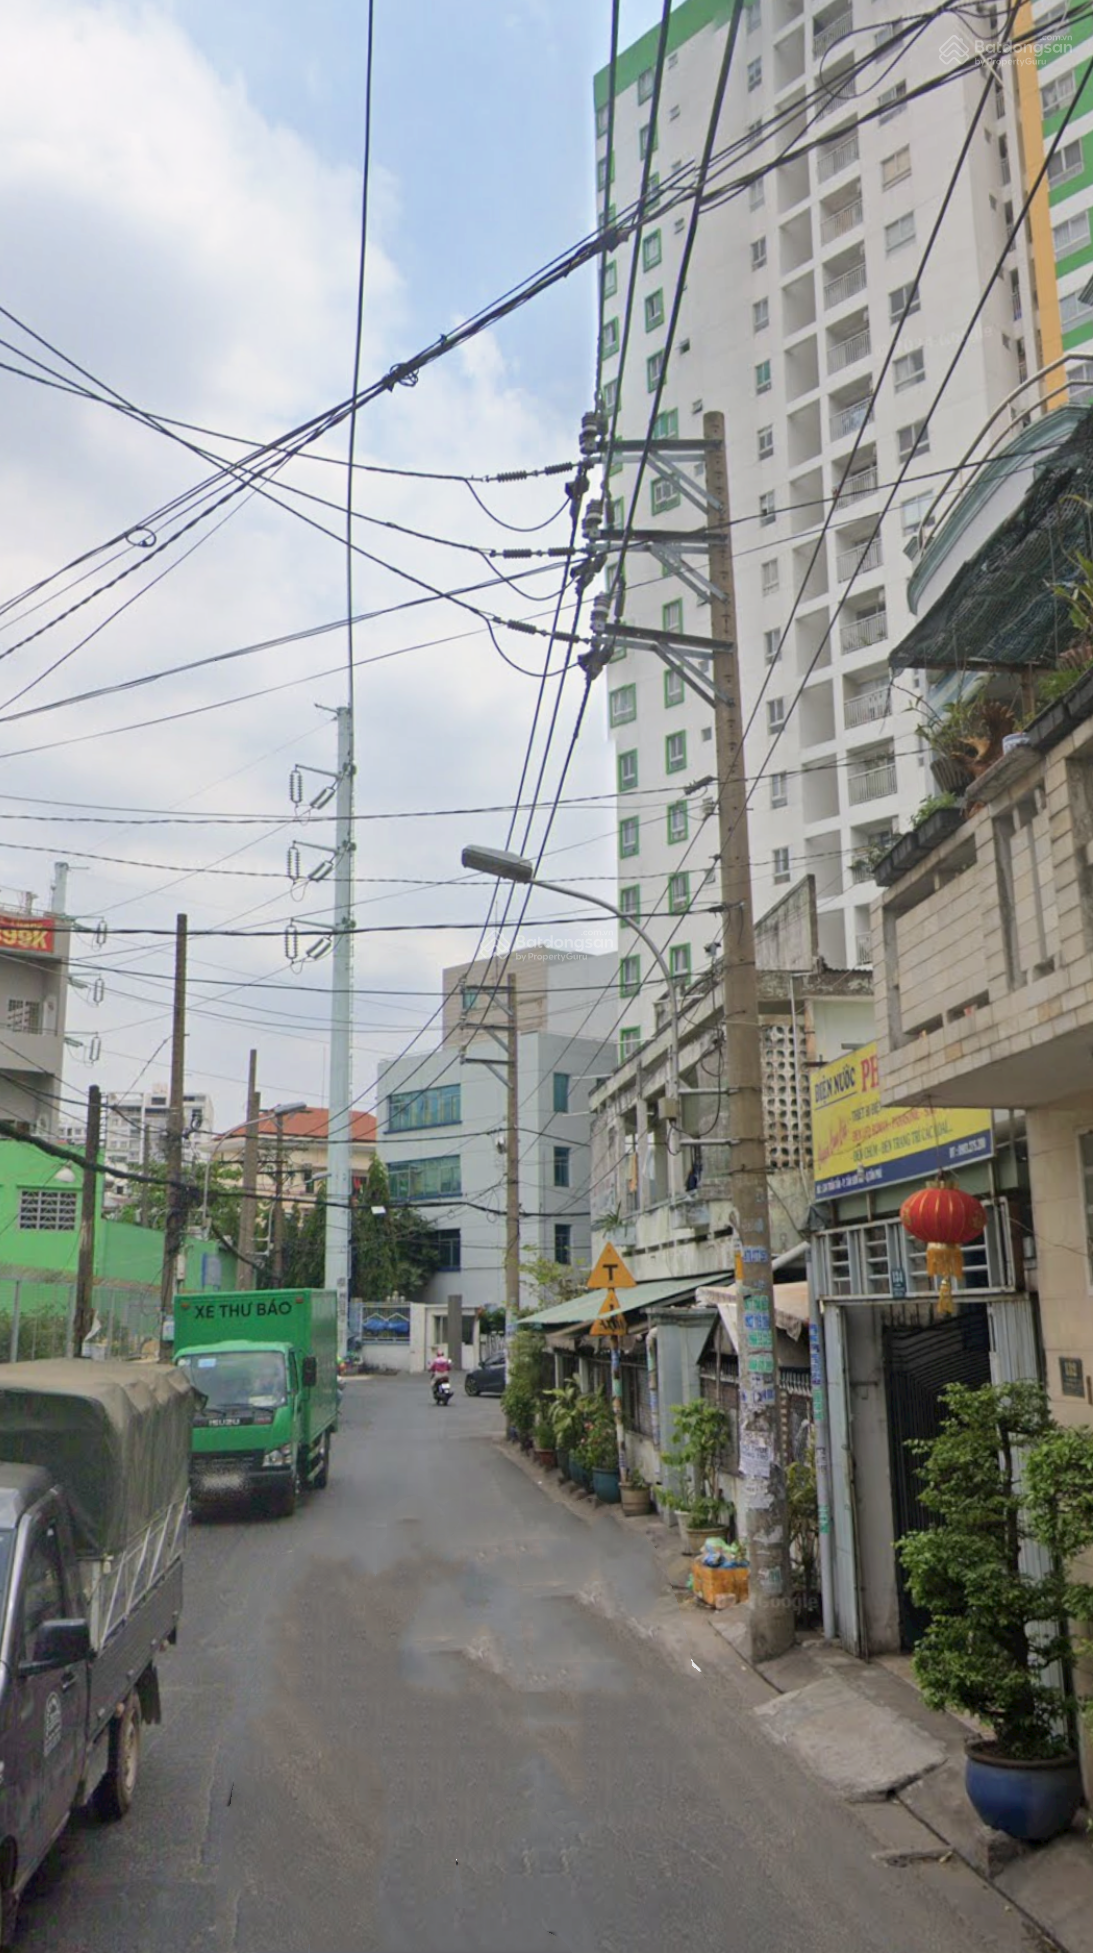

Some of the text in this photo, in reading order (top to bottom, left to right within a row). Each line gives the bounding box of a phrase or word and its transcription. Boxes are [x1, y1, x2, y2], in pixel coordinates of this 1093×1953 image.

[195, 1298, 292, 1319] XE THƯ BÁO
[208, 1418, 241, 1426] ISUZU
